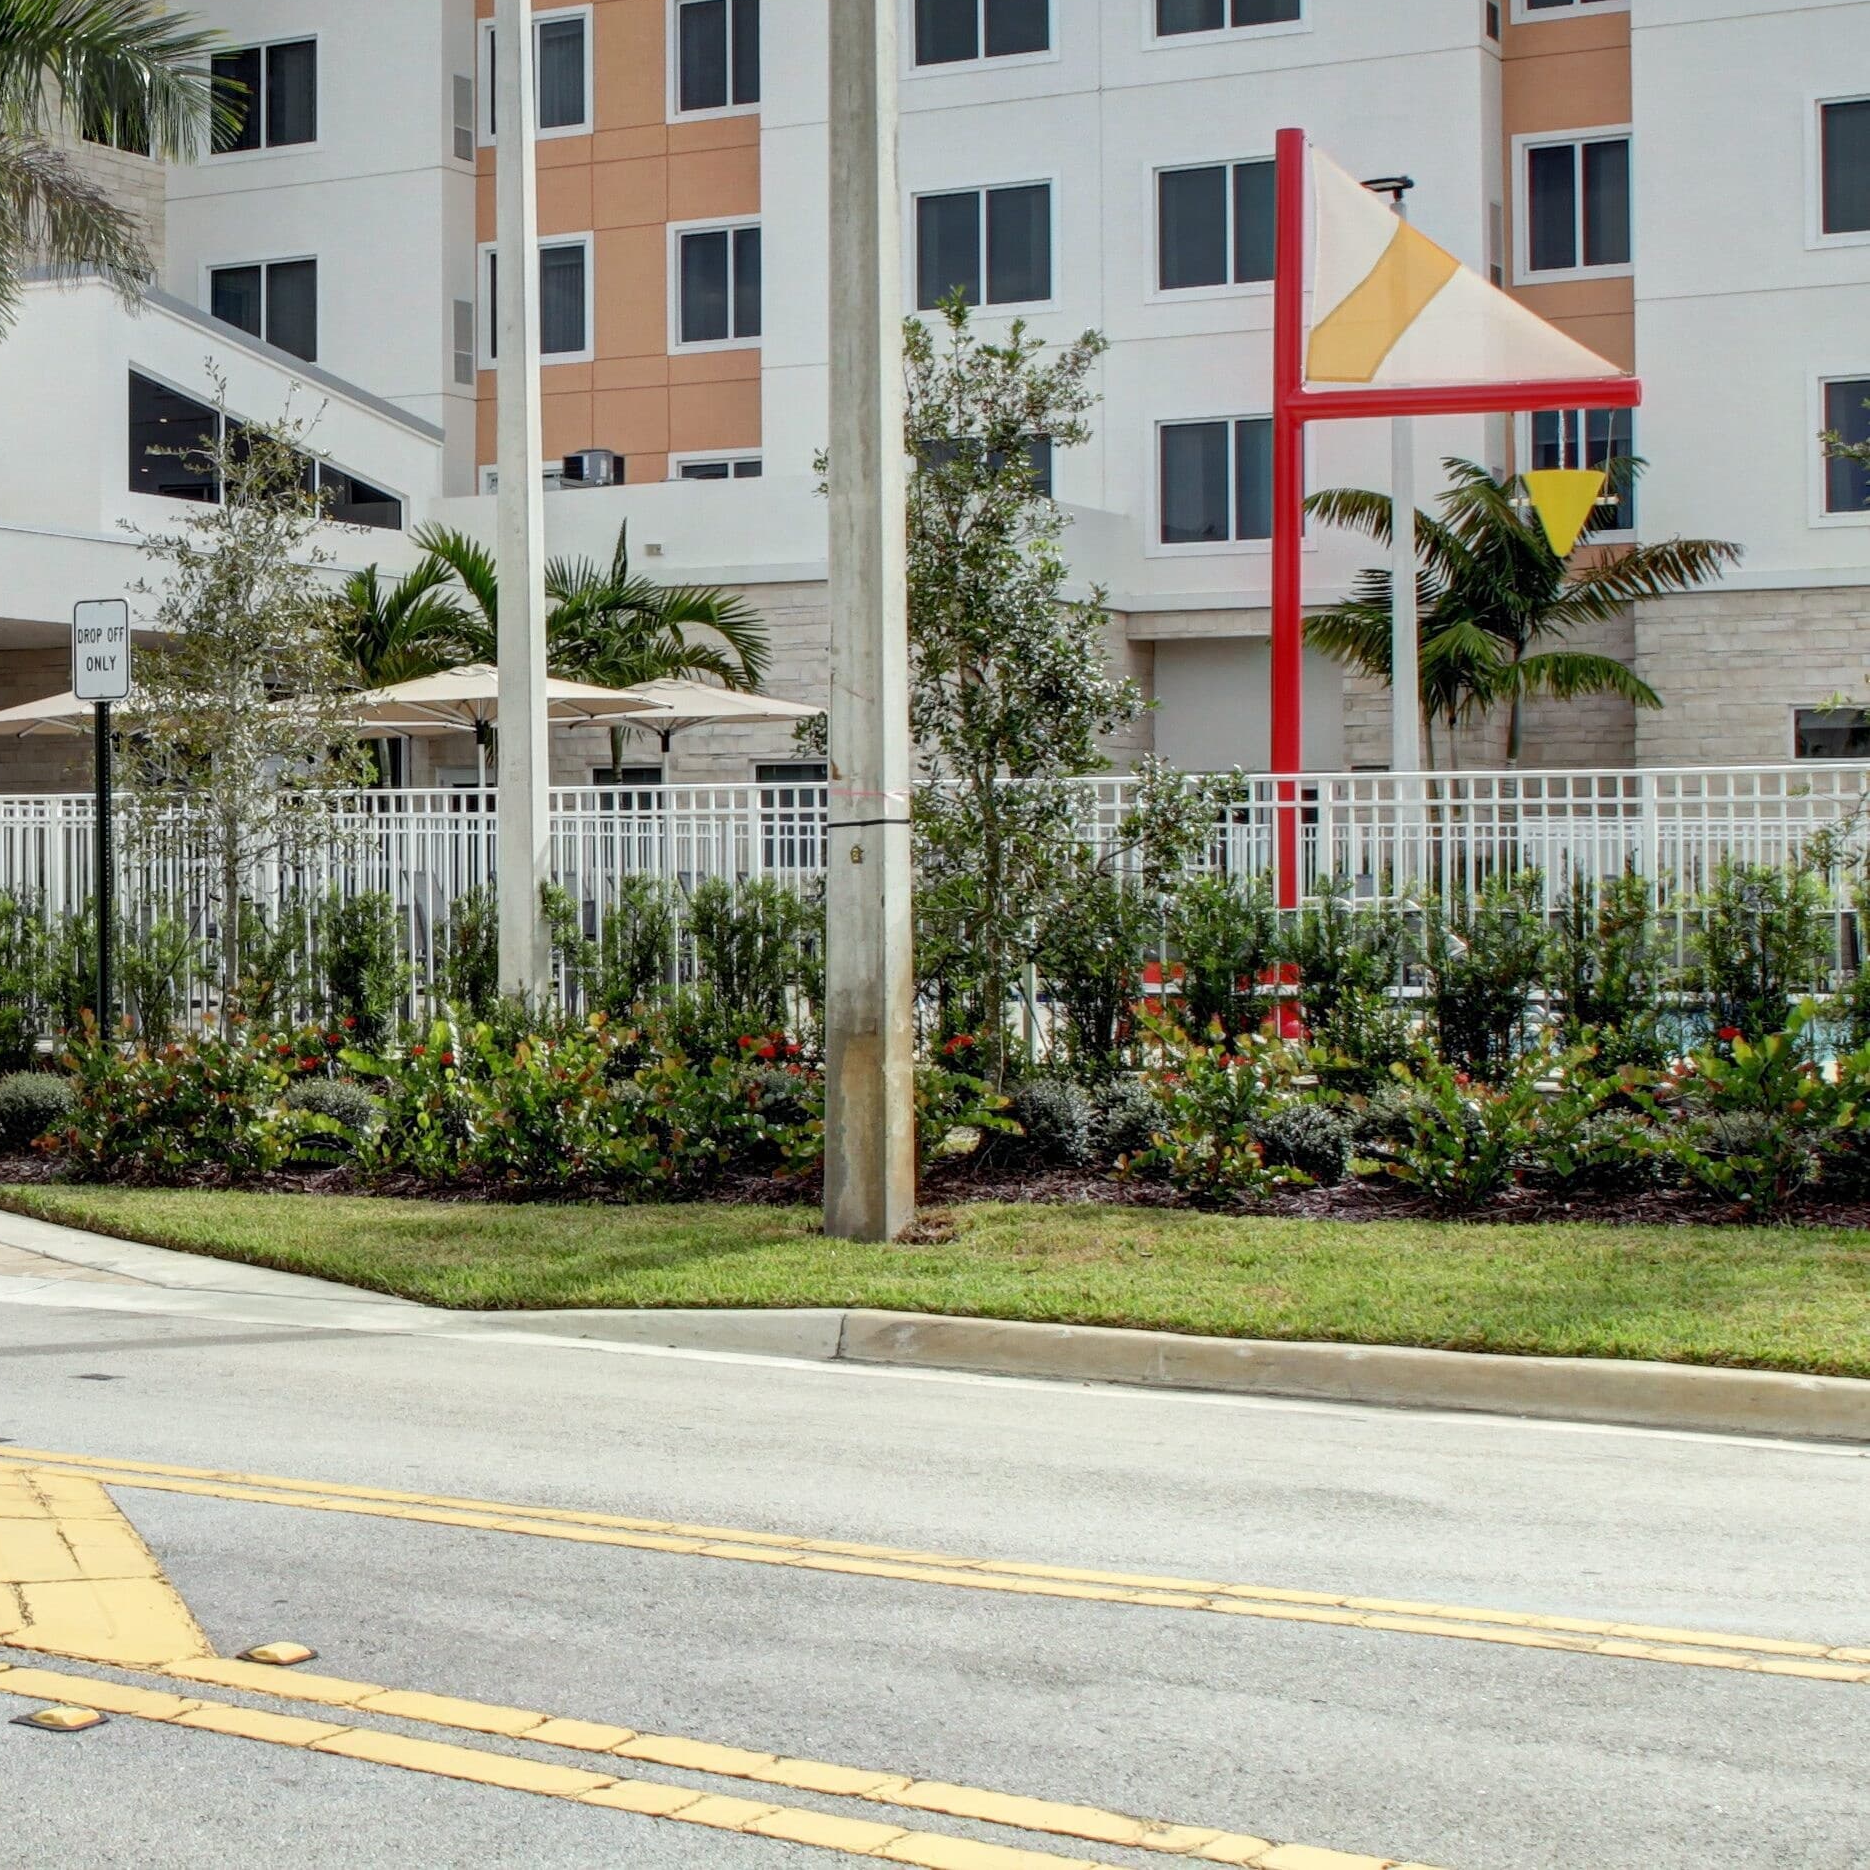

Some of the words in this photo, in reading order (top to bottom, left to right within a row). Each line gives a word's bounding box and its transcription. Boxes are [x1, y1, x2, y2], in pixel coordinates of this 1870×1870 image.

[77, 628, 103, 644] DROP
[107, 626, 125, 643] OFF
[86, 655, 117, 672] ONLY
